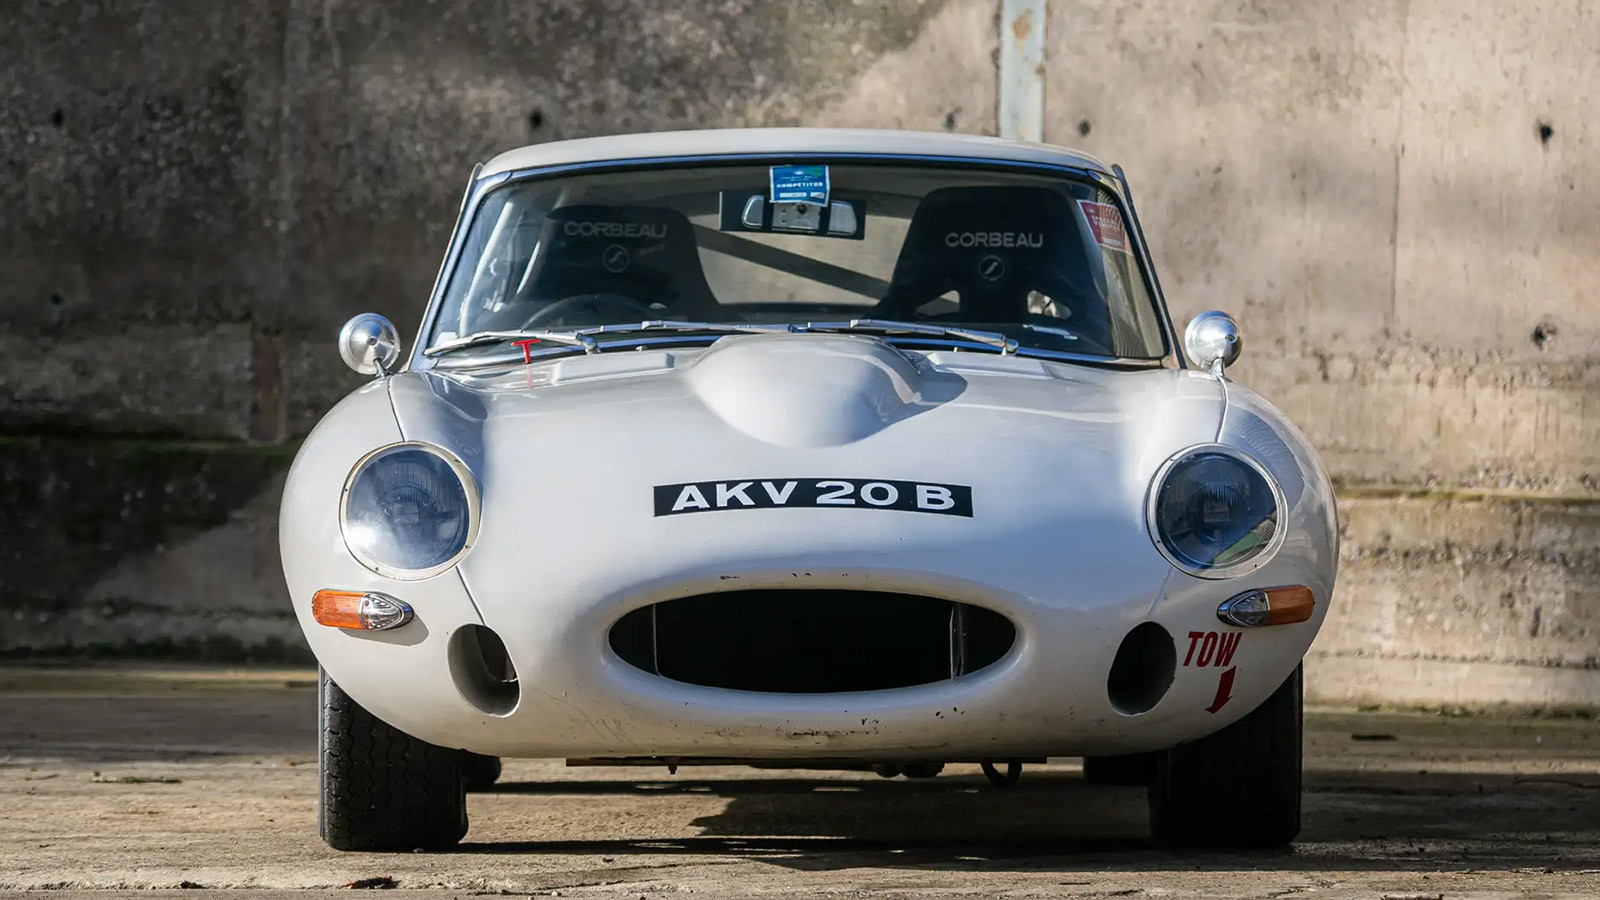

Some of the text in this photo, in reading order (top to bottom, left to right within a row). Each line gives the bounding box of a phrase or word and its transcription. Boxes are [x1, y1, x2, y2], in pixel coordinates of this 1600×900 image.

[776, 181, 823, 189] COMPETITOR
[564, 221, 667, 239] CORBEAU
[945, 232, 1044, 248] CORBEAU
[672, 480, 955, 511] AKV 20 B
[1183, 631, 1243, 667] TOW
